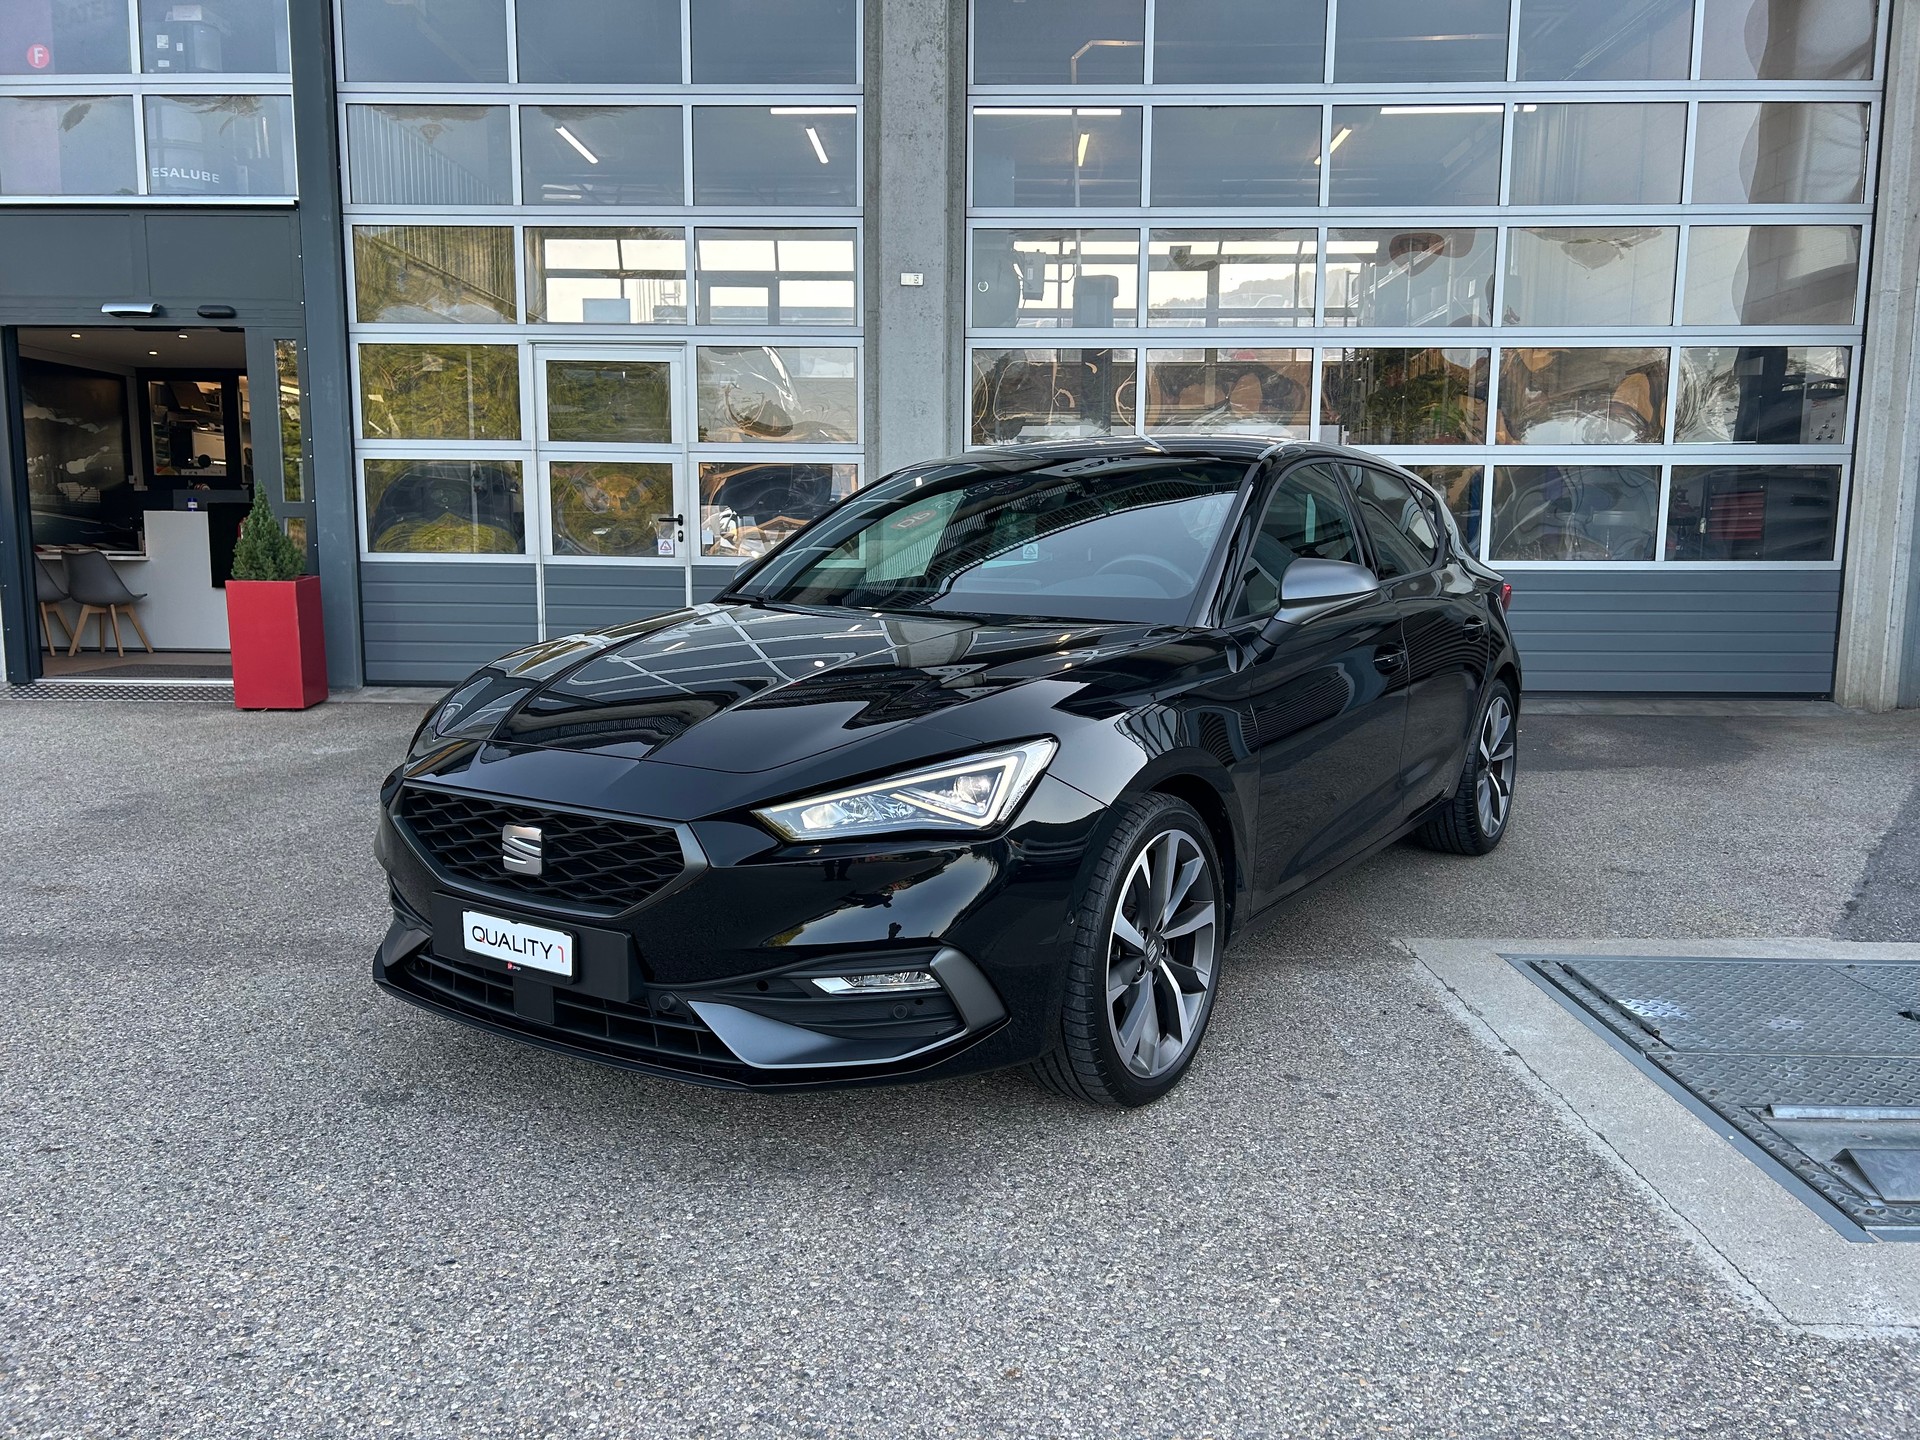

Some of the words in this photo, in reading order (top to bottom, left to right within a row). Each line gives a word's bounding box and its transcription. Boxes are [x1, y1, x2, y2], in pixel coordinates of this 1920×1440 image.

[33, 47, 44, 64] F
[151, 167, 220, 184] ESALUBE
[472, 926, 553, 959] QUALITY
